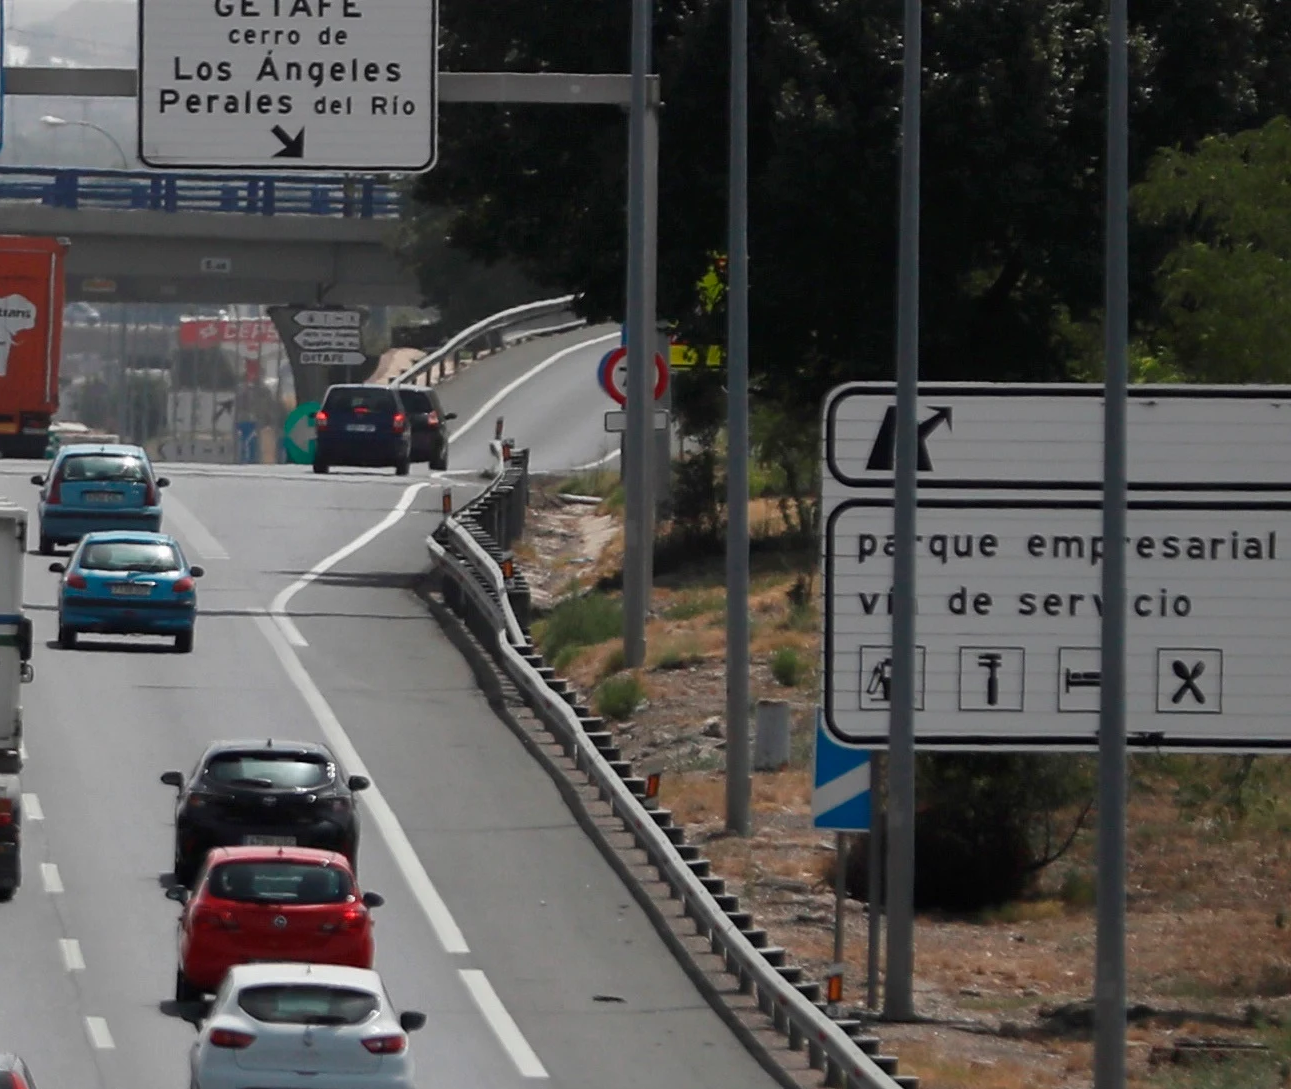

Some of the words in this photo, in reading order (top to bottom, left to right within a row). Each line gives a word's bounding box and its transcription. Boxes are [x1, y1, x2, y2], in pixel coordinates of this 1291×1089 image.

[228, 28, 301, 45] cerro
[317, 26, 348, 46] de
[173, 56, 232, 82] Los
[255, 50, 402, 88] Ángeles
[158, 88, 293, 115] Perales
[314, 96, 352, 116] del
[371, 95, 416, 116] Río
[858, 531, 1000, 564] paque
[1027, 531, 1277, 565] empesarial
[858, 586, 919, 617] ví
[947, 586, 993, 616] de
[1018, 587, 1193, 617] sercio
